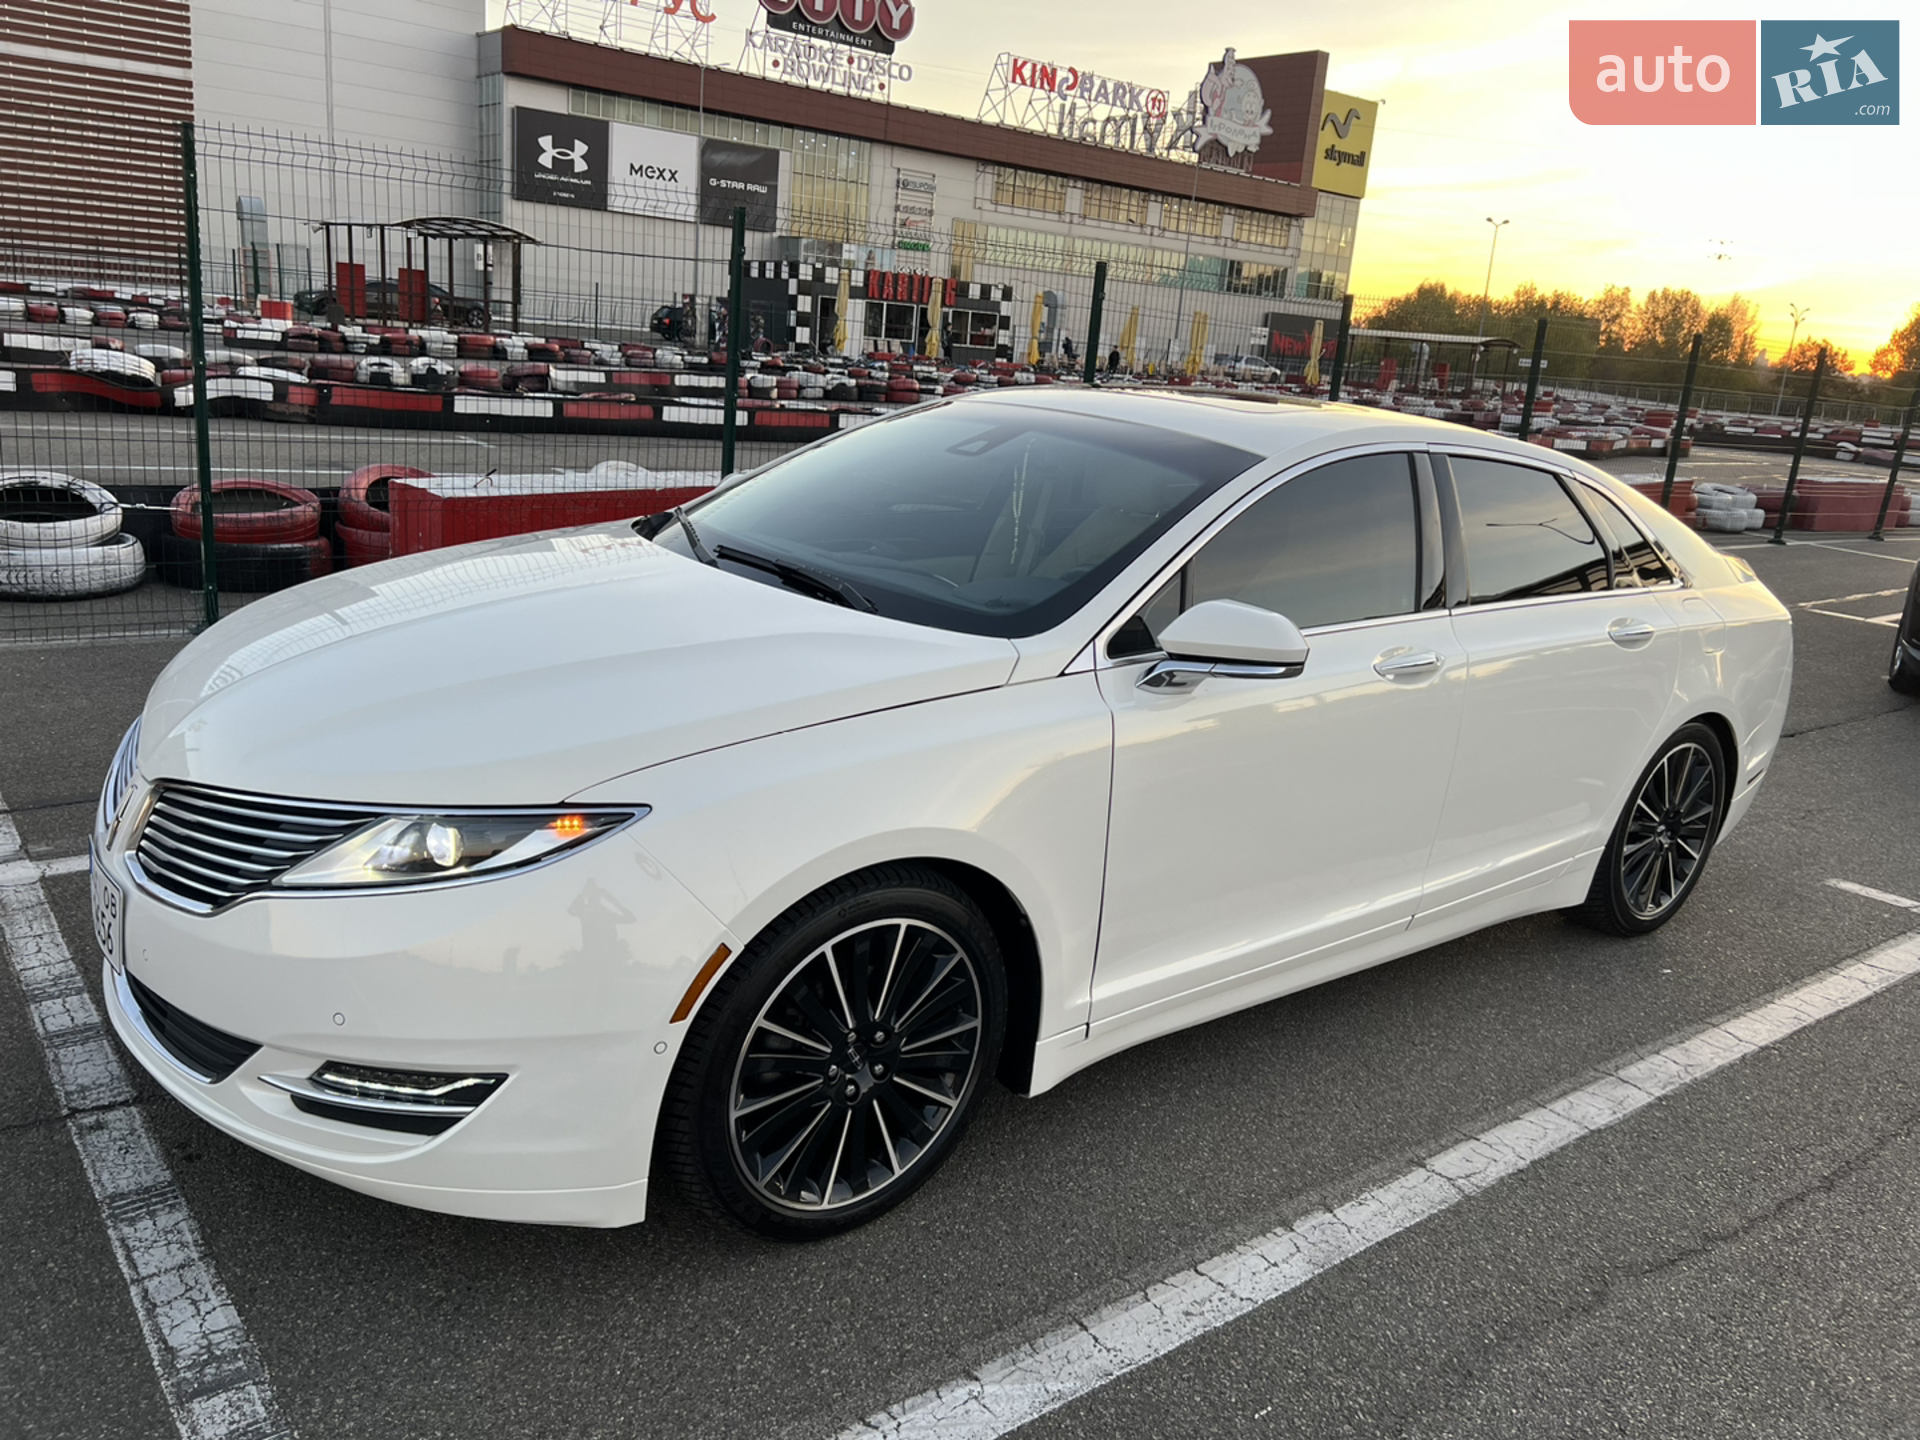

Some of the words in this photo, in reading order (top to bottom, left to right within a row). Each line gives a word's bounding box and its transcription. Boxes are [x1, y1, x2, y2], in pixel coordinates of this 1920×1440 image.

[792, 20, 874, 48] ENTERTAINMENT
[745, 28, 845, 67] KARAOKE
[857, 54, 913, 82] DISCO
[783, 57, 875, 93] BOWLING
[1323, 143, 1367, 167] skymall
[708, 177, 745, 191] G-STAR
[746, 183, 768, 194] RAW
[868, 269, 958, 307] KARTIG
